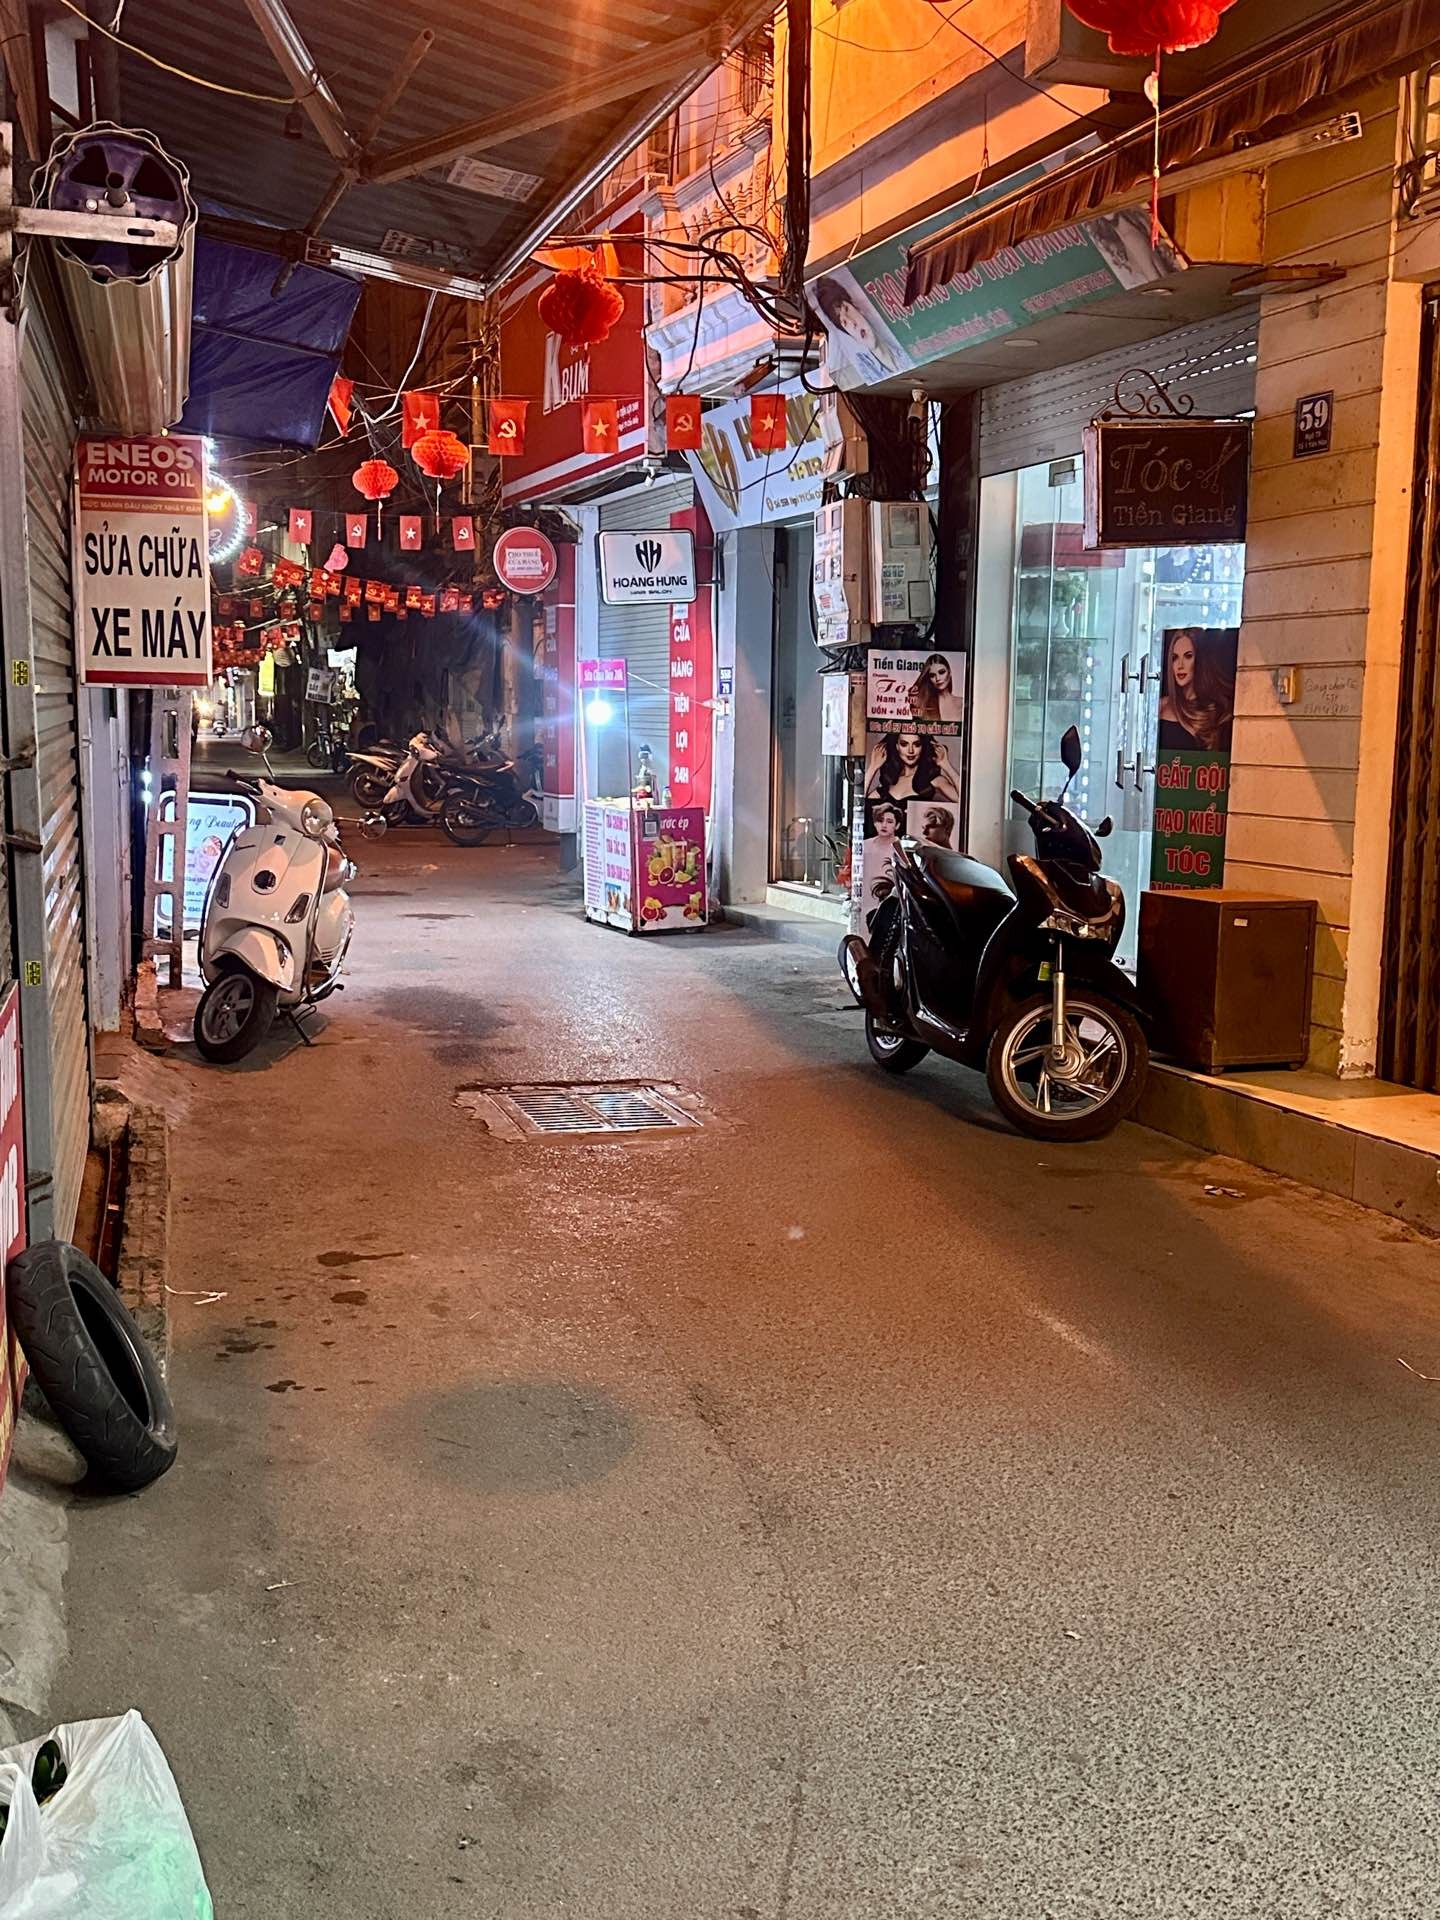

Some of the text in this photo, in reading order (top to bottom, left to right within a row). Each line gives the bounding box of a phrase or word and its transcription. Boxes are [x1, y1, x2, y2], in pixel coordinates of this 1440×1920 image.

[1300, 400, 1329, 431] 59
[86, 442, 195, 470] ENEOS
[1109, 438, 1193, 494] Tóc
[87, 468, 195, 488] MOTOR OIL
[1113, 500, 1237, 527] Tiền Giang
[84, 520, 202, 578] SỬA CHỮA
[91, 596, 206, 659] XE MÁY
[674, 619, 690, 642] CỬA
[671, 656, 693, 678] HÀNG
[674, 692, 689, 717] TIỆN
[876, 695, 896, 703] Nam
[675, 730, 688, 752] LỢI
[674, 768, 689, 783] 24H
[1157, 757, 1227, 796] CẮT GỘI
[678, 817, 689, 831] ép
[1155, 803, 1226, 838] TẠO KIỂU
[1165, 845, 1211, 876] TÓC
